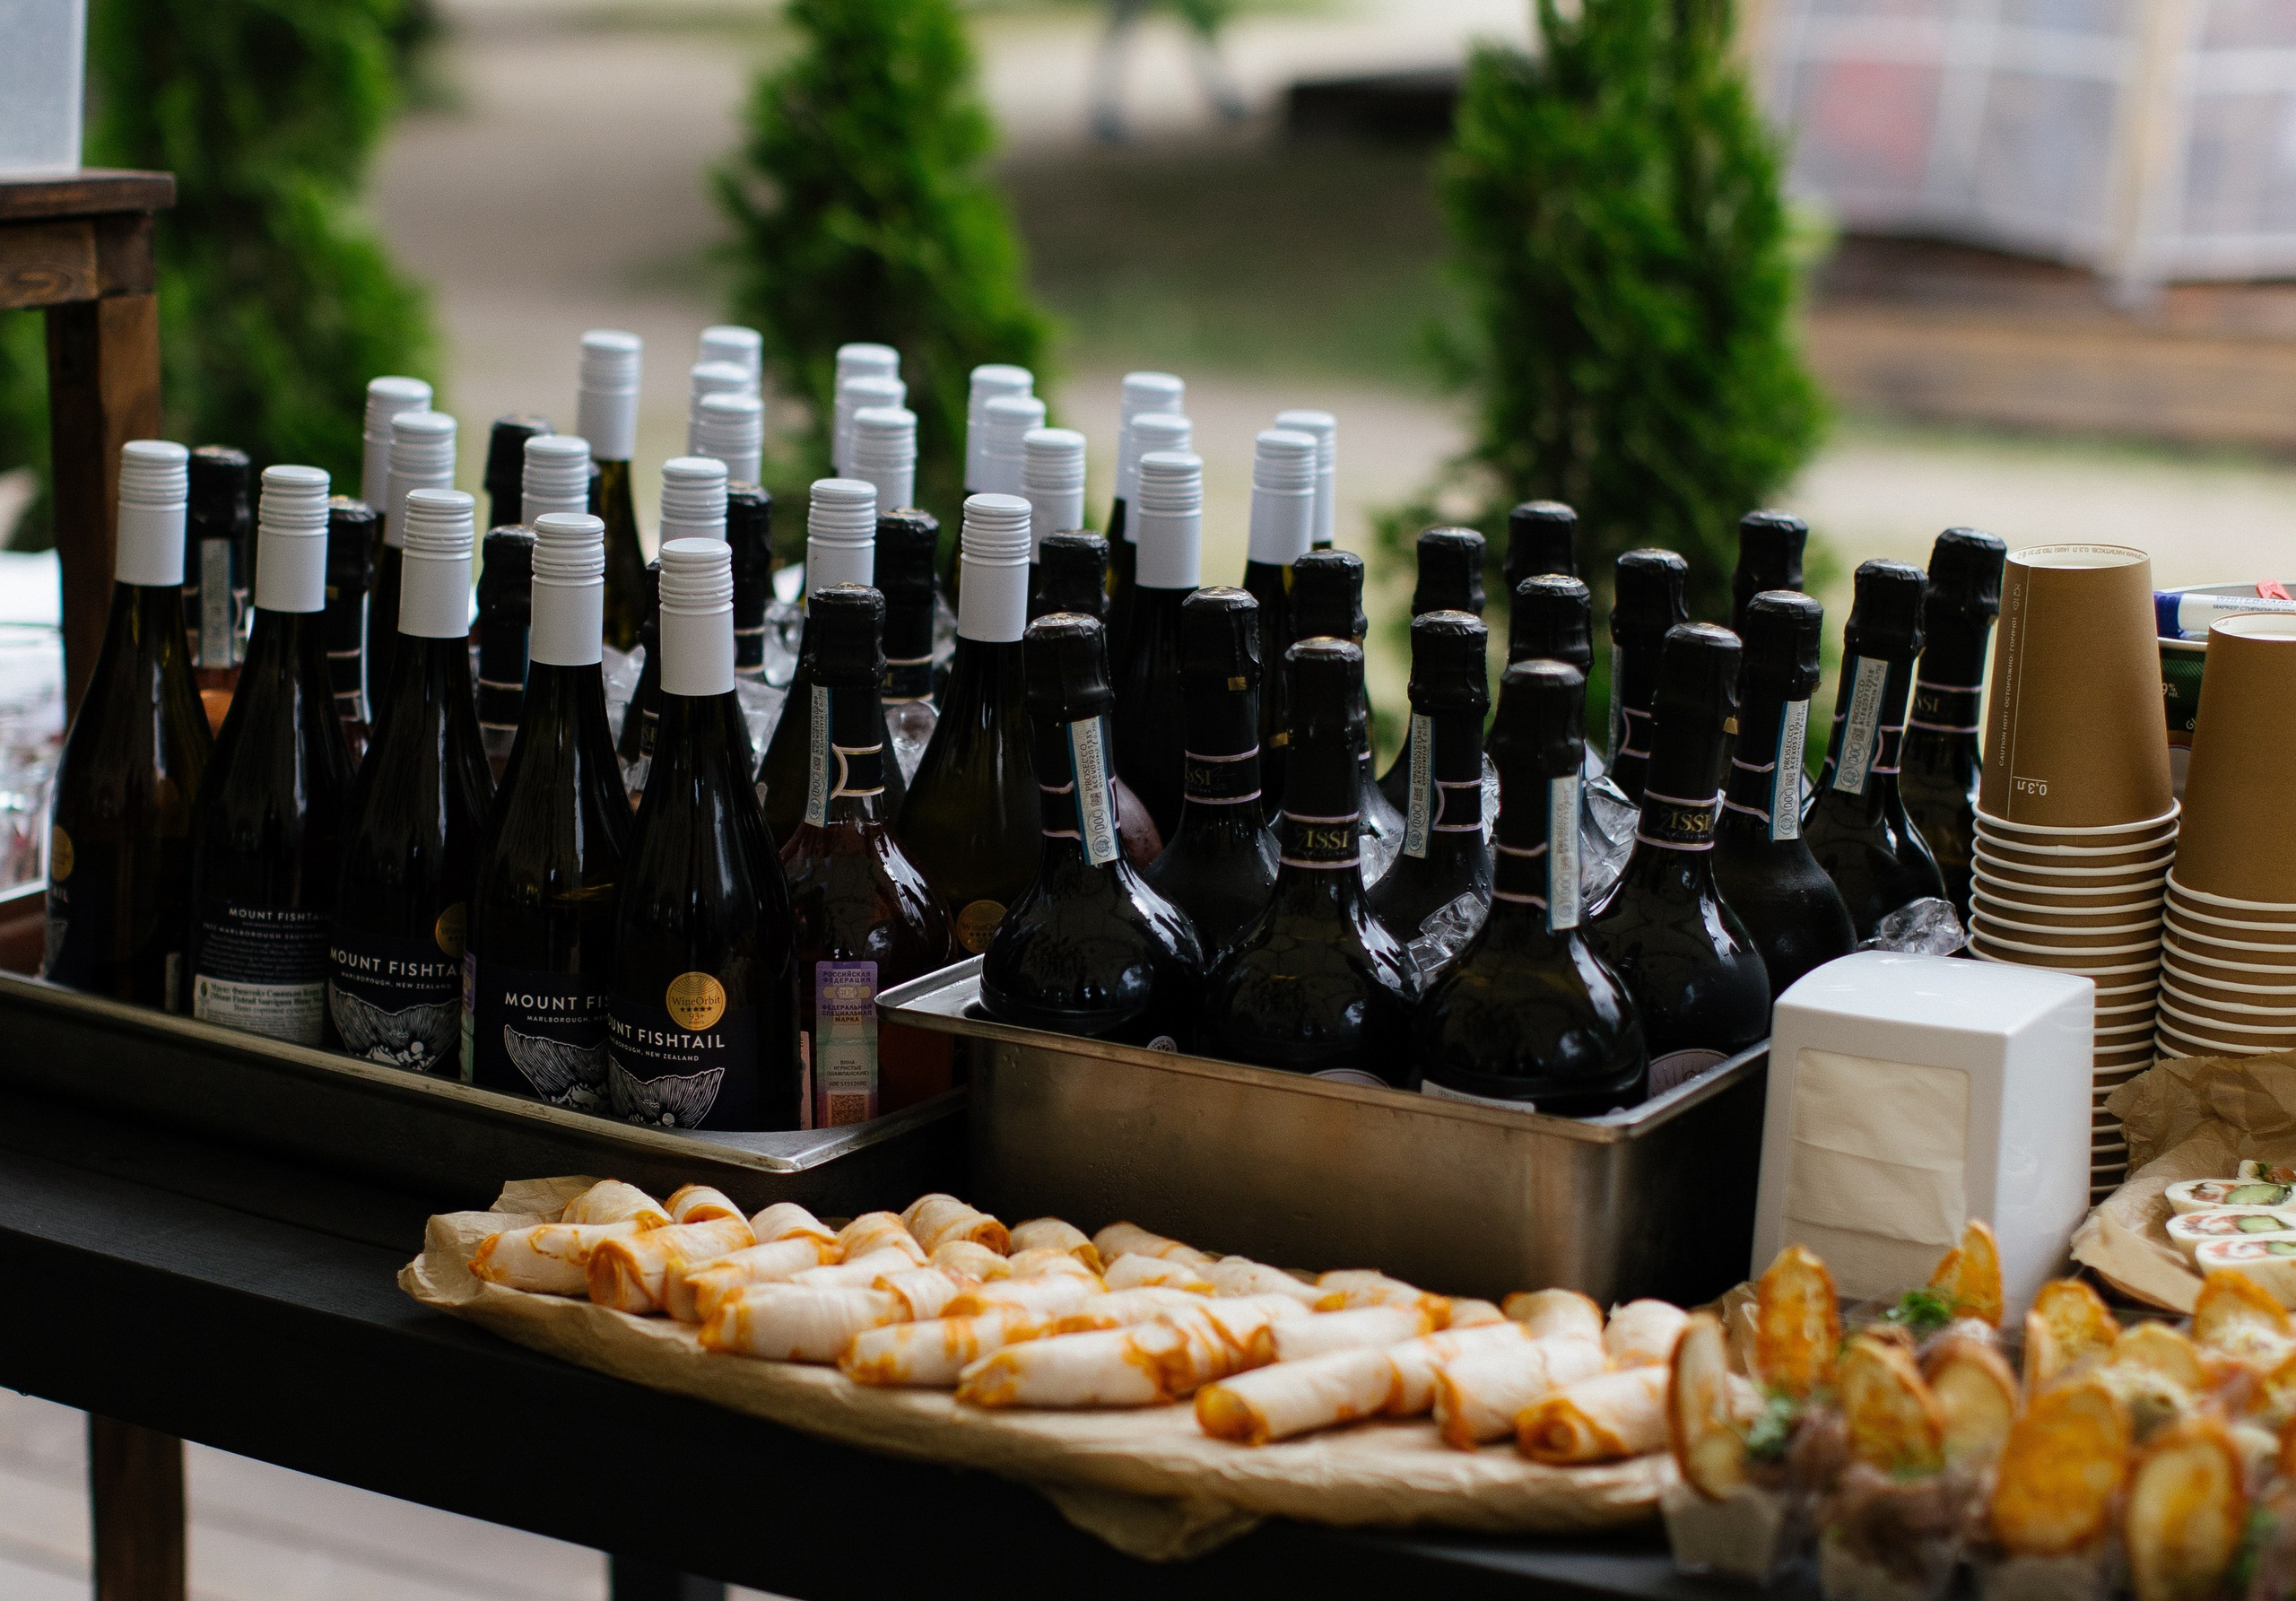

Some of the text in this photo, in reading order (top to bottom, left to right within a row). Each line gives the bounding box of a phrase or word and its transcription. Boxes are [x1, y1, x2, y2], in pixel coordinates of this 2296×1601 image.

[1782, 724, 1795, 770] PROSECCO
[1848, 744, 1861, 763] DOC
[1079, 743, 1092, 791] PROSECCO
[1782, 791, 1794, 808] DOC
[1091, 812, 1105, 831] DOC
[1412, 806, 1422, 824] DOC
[229, 906, 274, 922] MOUNT
[329, 945, 382, 973] MOUNT
[396, 982, 414, 990] NEW
[415, 982, 453, 991] ZEALAND
[505, 991, 578, 1011] MOUNT
[672, 996, 721, 1006] WineOrbit
[526, 1014, 591, 1024] MARLBOROUGH,
[689, 1012, 705, 1021] 93+
[638, 1028, 726, 1049] FISHTAIL
[645, 1050, 662, 1058] NEW
[663, 1053, 700, 1062] ZEALAND
